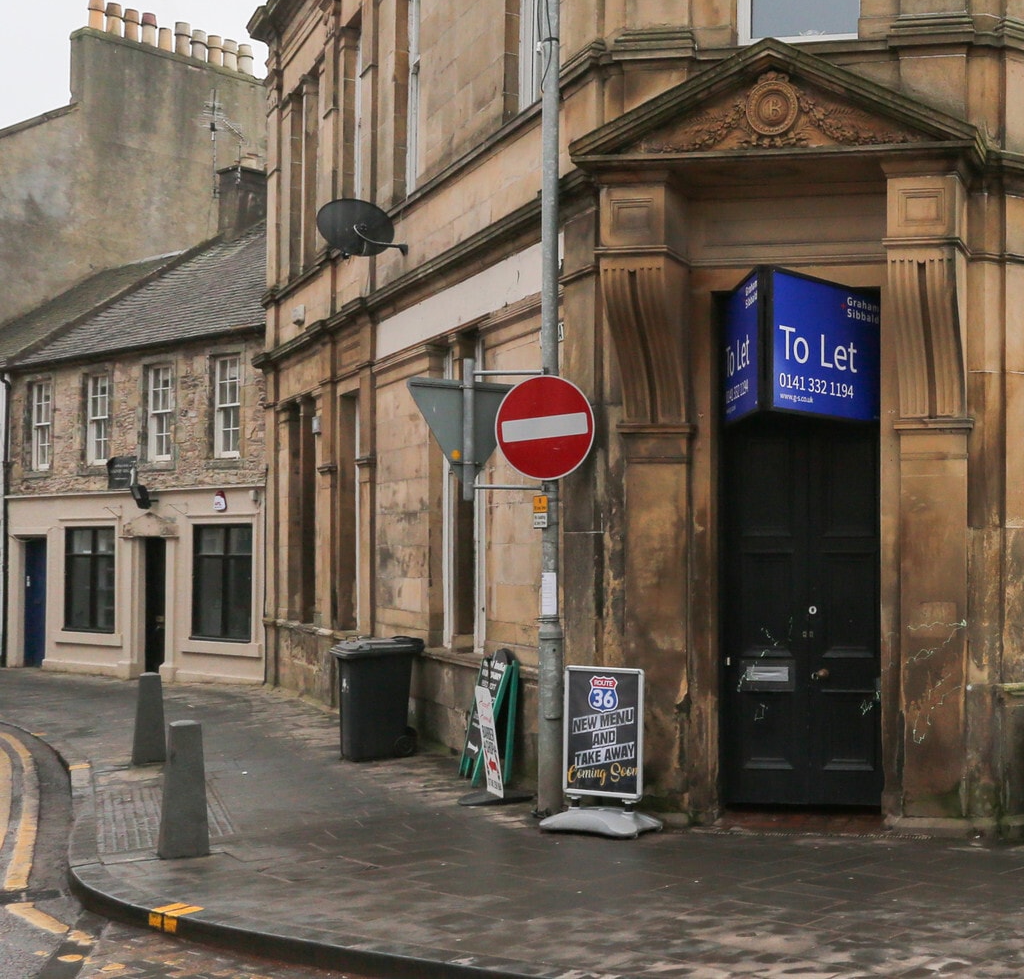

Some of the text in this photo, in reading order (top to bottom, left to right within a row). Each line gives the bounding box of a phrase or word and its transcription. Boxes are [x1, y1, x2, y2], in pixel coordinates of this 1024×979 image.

[847, 309, 880, 324] Sibbald
[726, 334, 750, 377] To Let
[779, 325, 857, 373] To Let
[779, 373, 854, 399] 0141 332 1194
[592, 689, 615, 708] 36
[573, 708, 634, 733] NEW MENU
[593, 730, 616, 747] AND
[575, 744, 635, 767] TAKE AWAY
[567, 762, 639, 786] Coming Soon
